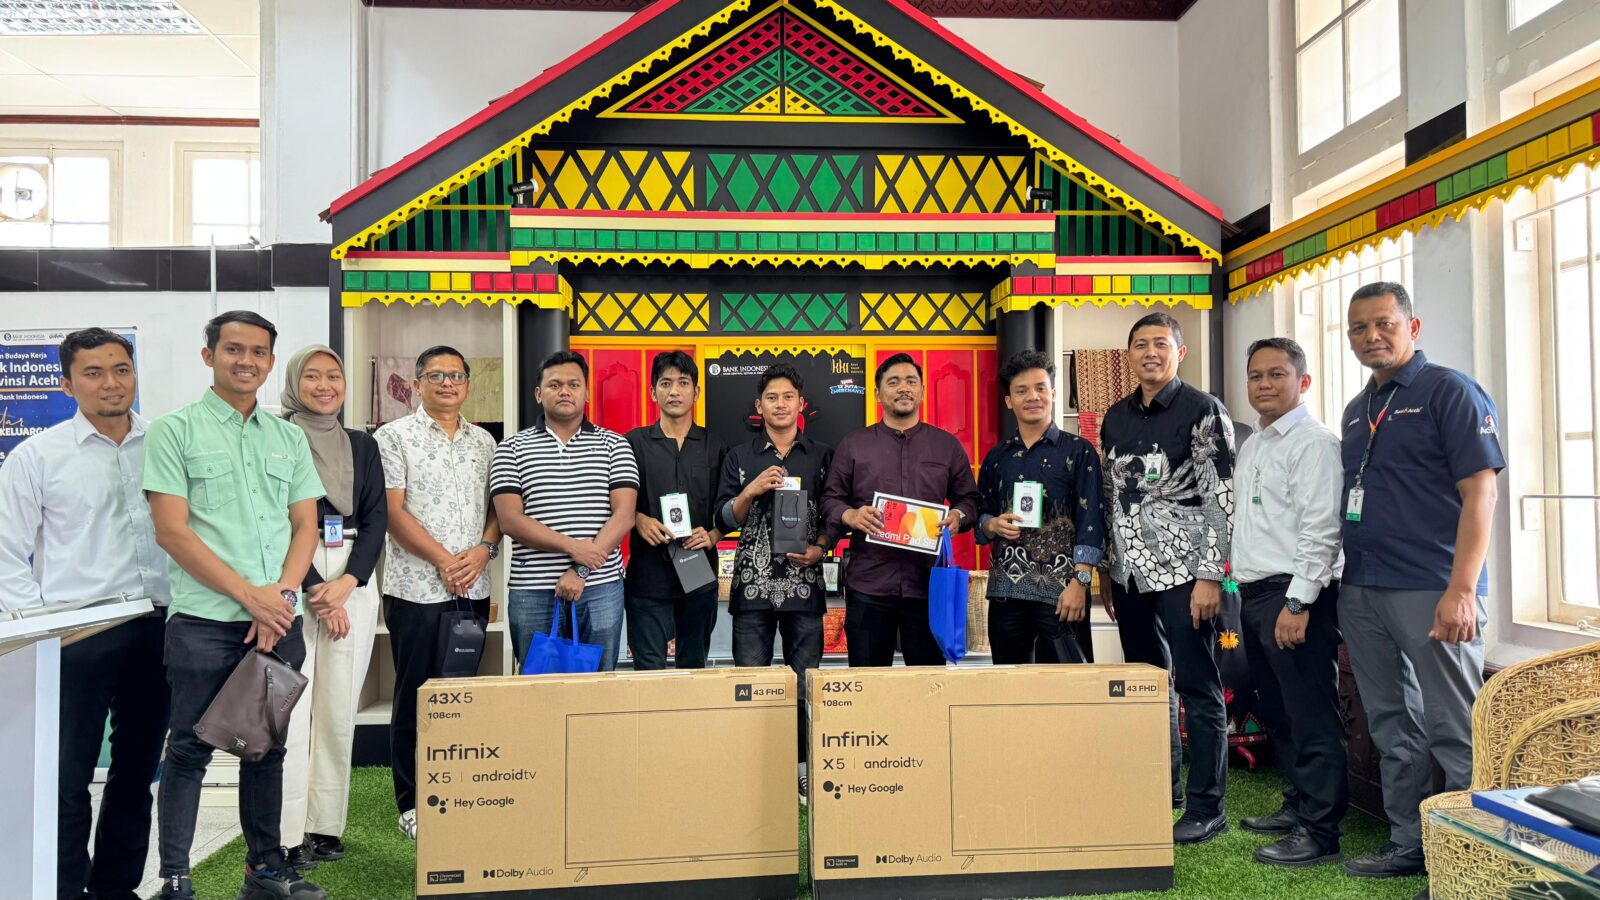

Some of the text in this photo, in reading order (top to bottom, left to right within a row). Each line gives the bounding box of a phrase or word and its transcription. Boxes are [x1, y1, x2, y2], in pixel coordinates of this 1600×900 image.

[5, 352, 30, 360] Budaya
[30, 352, 48, 360] Kerja
[10, 361, 62, 373] Indonesi
[29, 374, 59, 386] Aceh
[1112, 684, 1122, 692] AI
[428, 712, 460, 720] 108cm
[822, 730, 889, 748] Infinix
[426, 742, 500, 762] Infinix
[822, 758, 845, 770] X5
[428, 772, 452, 784] X5
[848, 782, 904, 794] Hey Google
[454, 796, 514, 809] Hey Google
[888, 854, 942, 864] Dolby Audio
[496, 867, 554, 878] Dolby Audio
